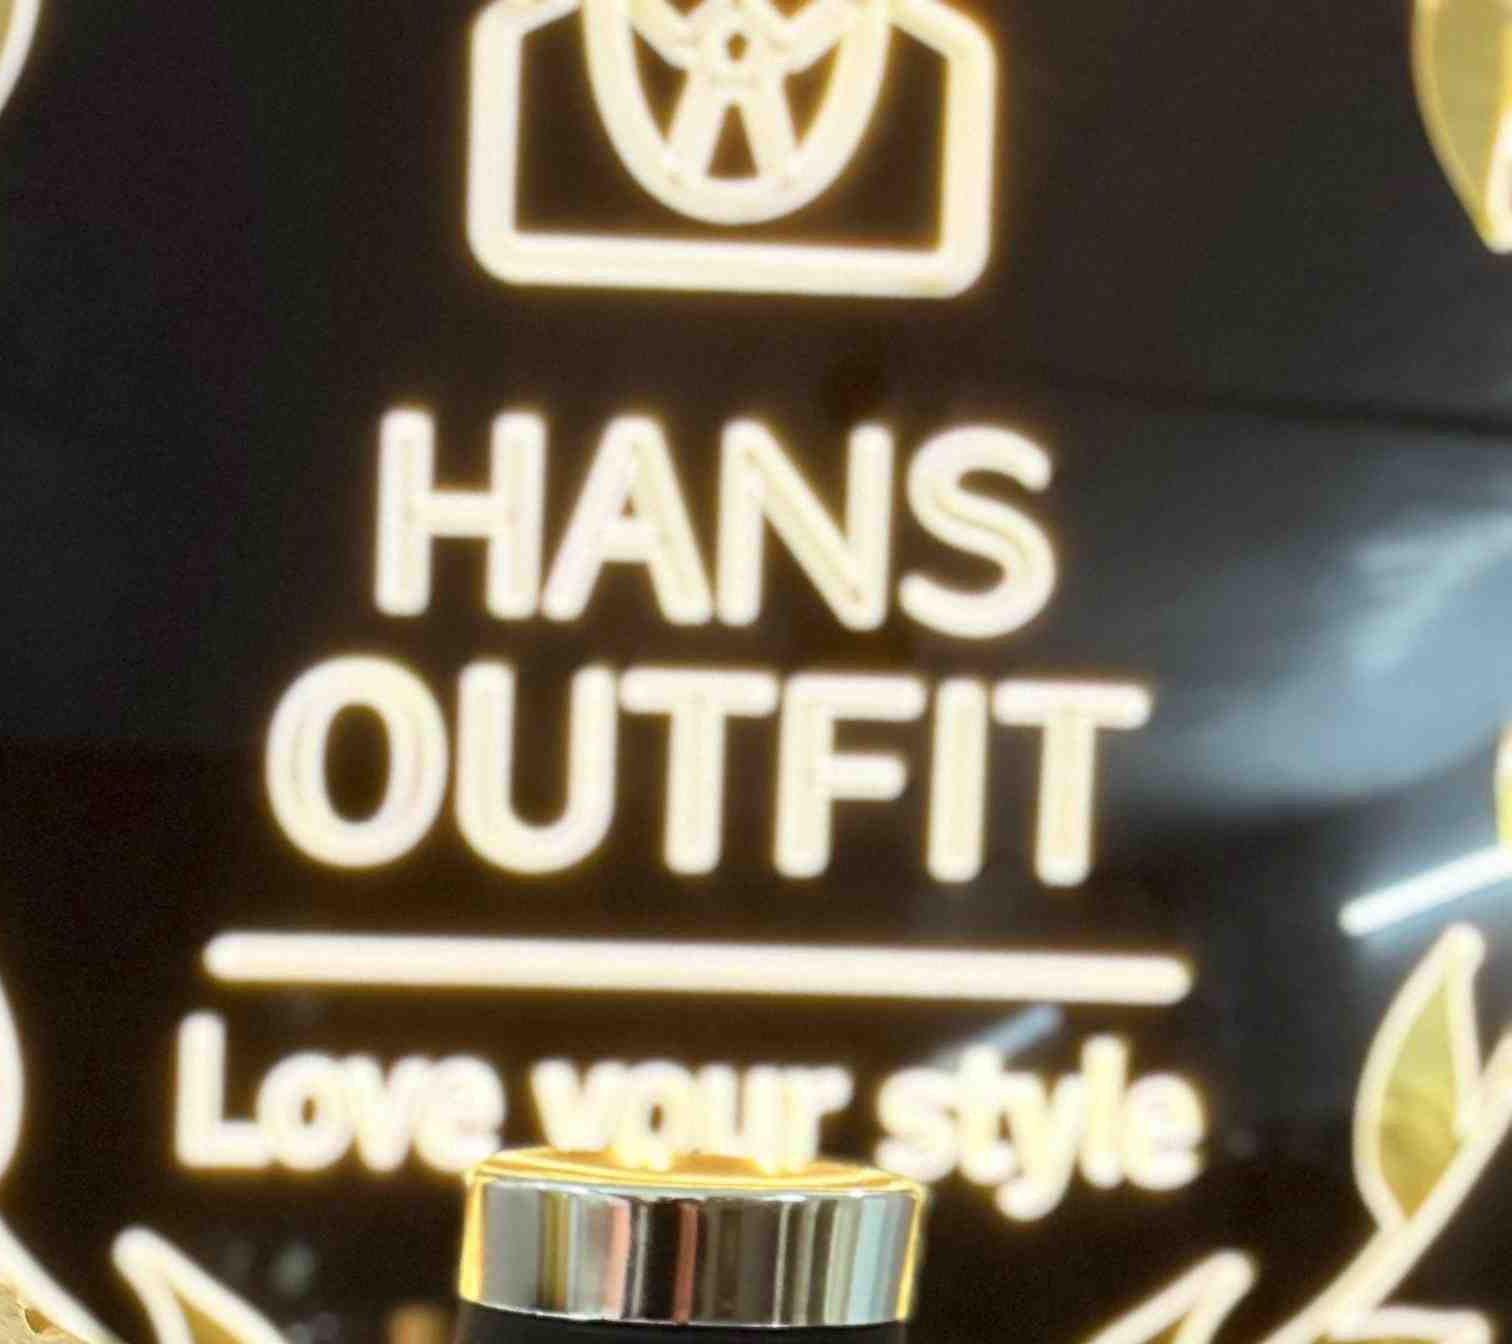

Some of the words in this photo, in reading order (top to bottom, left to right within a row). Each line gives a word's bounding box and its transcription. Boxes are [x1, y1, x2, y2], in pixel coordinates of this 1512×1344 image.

[375, 409, 1056, 639] HANS
[266, 656, 1152, 885] OUTFIT
[175, 1013, 504, 1172] Love
[876, 1034, 1204, 1220] style
